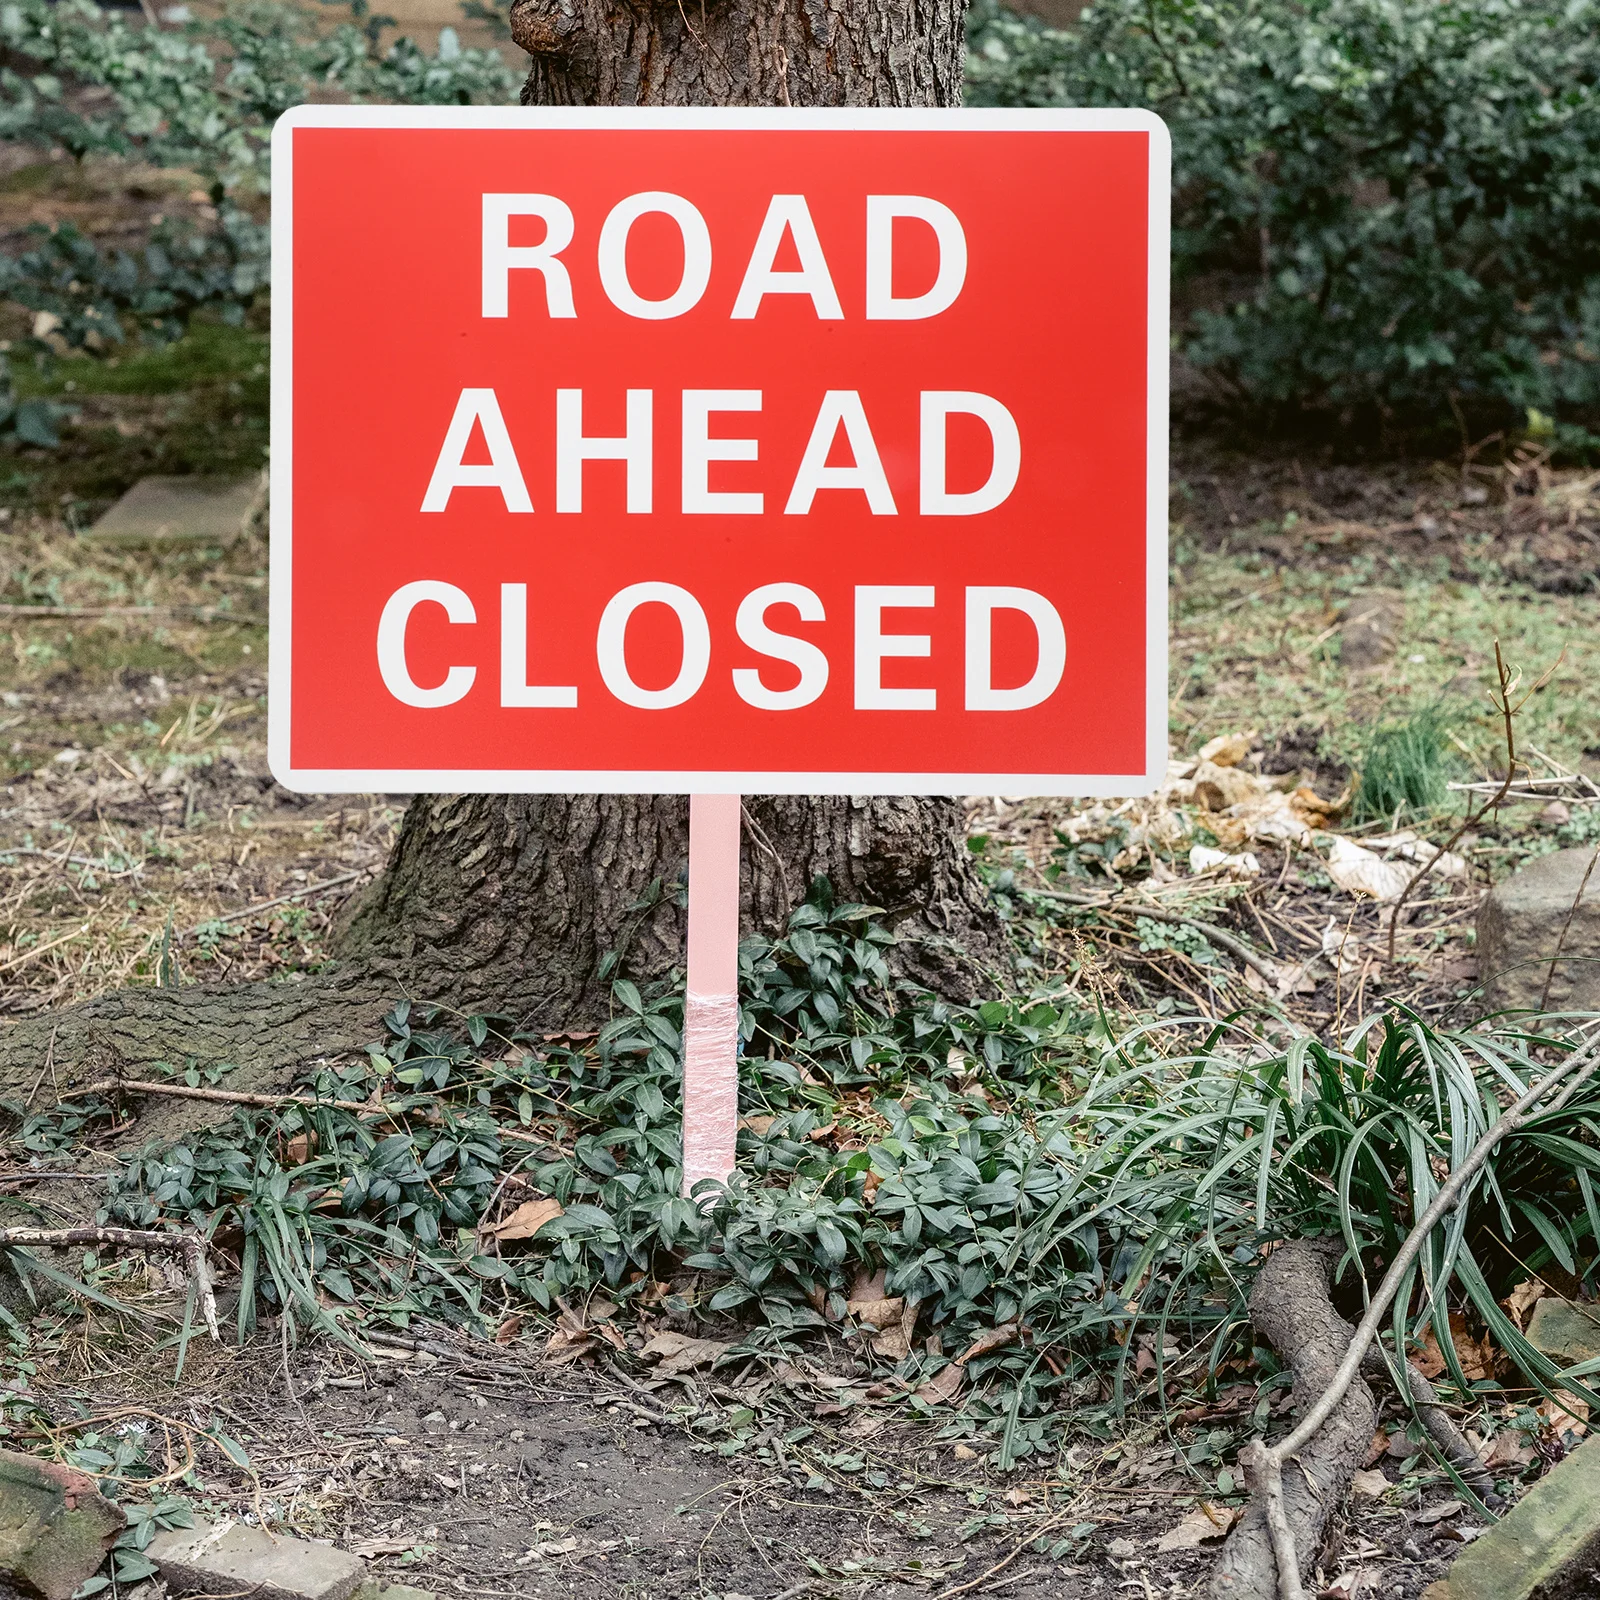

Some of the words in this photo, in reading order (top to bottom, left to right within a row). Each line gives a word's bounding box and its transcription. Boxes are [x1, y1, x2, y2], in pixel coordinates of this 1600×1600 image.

[481, 191, 968, 321] ROAD
[420, 388, 1022, 516] AHEAD
[376, 580, 1067, 712] CLOSED
